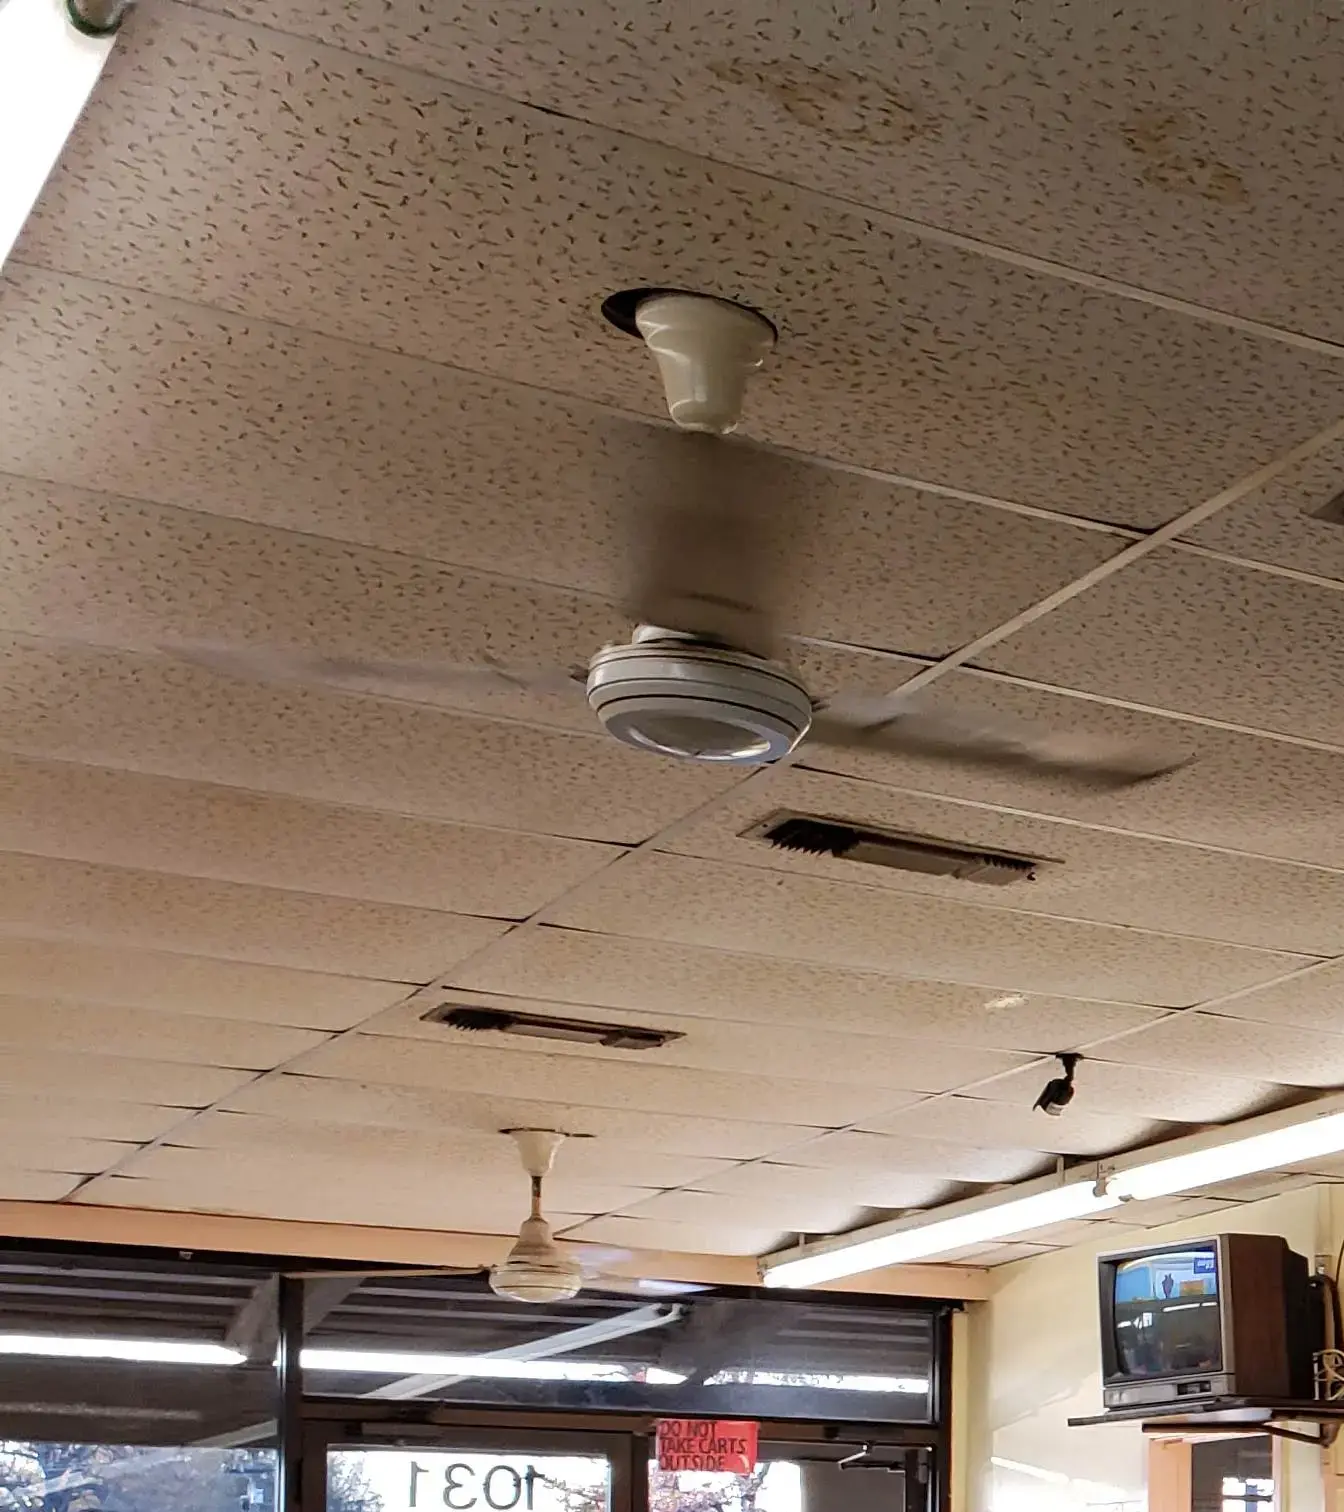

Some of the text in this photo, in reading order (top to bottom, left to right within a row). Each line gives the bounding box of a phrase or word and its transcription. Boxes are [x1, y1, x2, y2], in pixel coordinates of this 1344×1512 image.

[660, 1421, 717, 1438] DO NOT
[660, 1438, 748, 1454] TAKE CARTS
[660, 1455, 725, 1471] OUTSIDE
